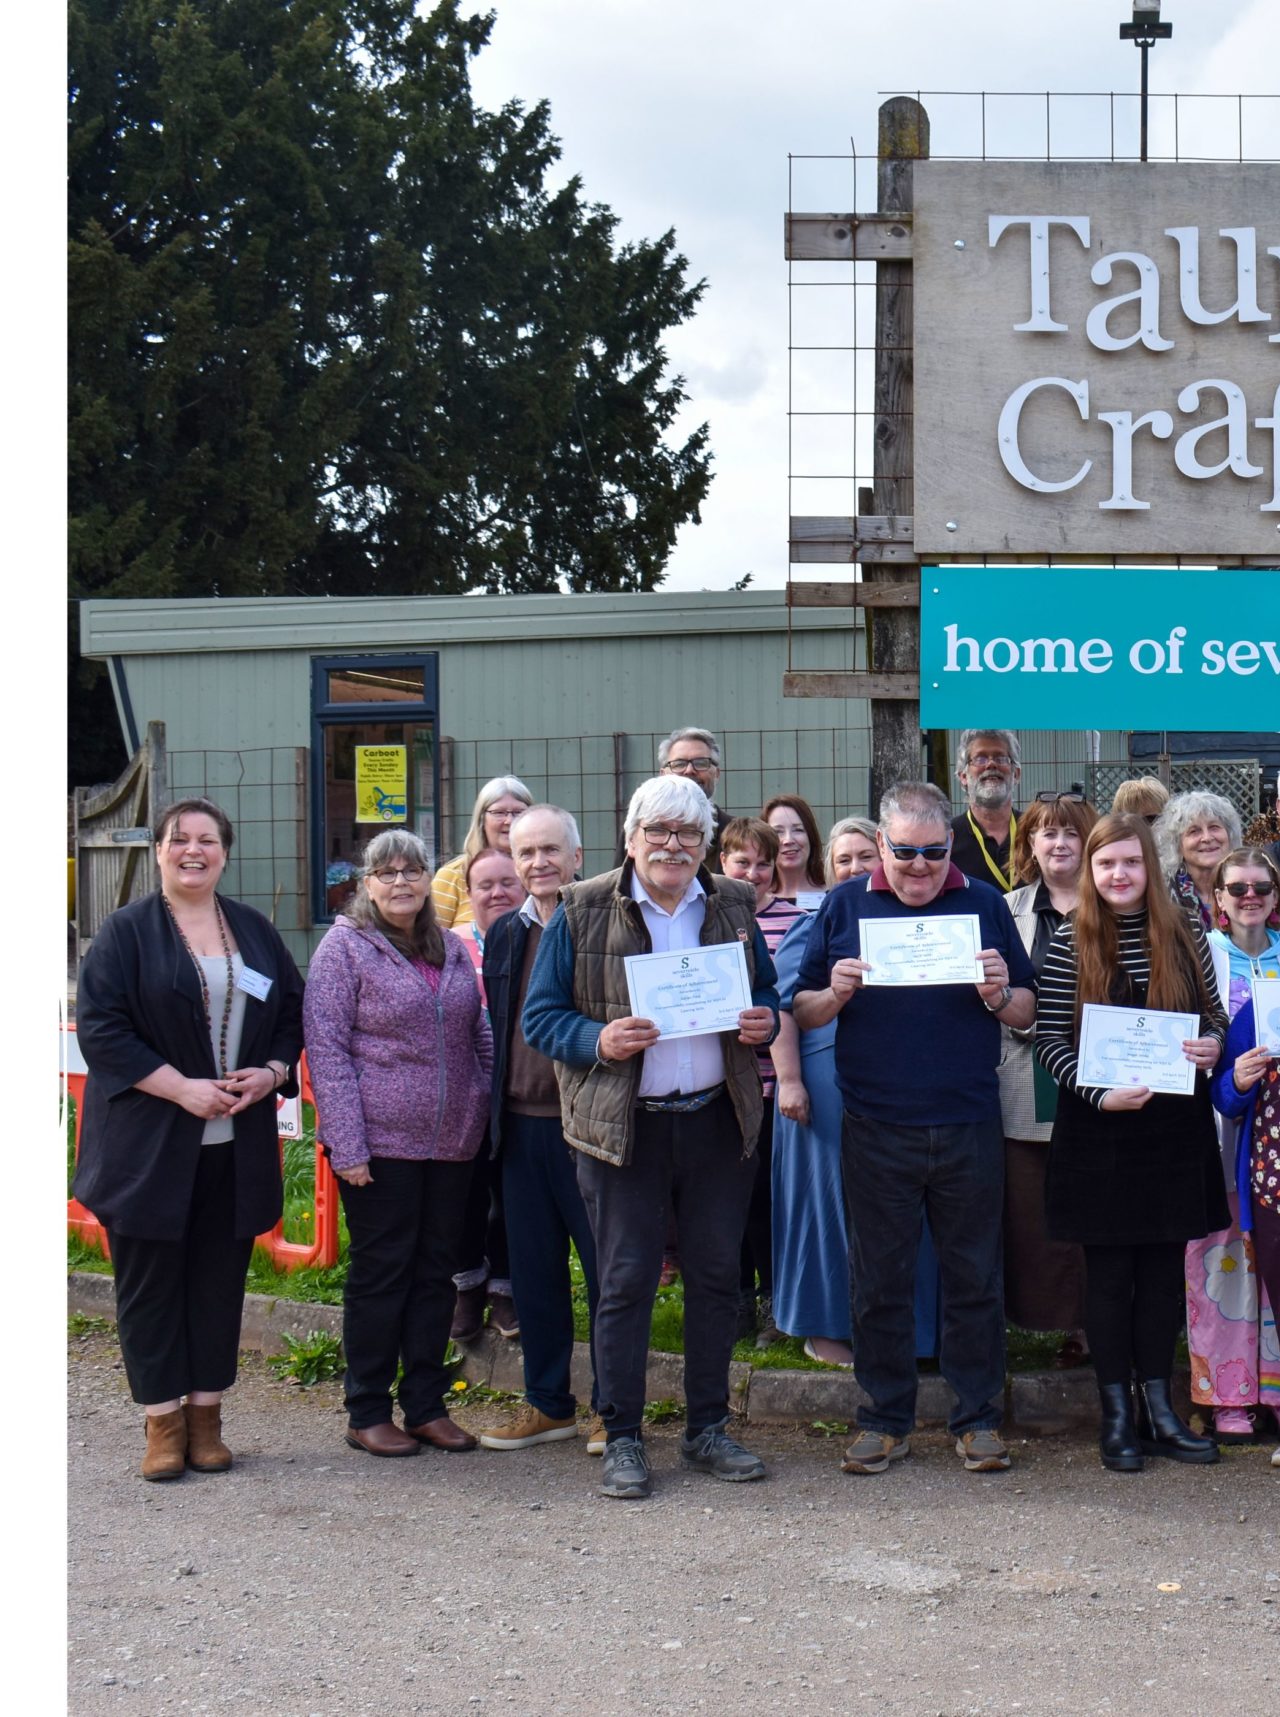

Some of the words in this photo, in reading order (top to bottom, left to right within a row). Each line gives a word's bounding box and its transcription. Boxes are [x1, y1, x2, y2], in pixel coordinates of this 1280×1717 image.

[943, 624, 1113, 673] home
[1129, 627, 1187, 674] of
[363, 749, 400, 757] Carboot
[916, 923, 925, 933] S
[681, 956, 690, 969] S
[1136, 1016, 1146, 1028] S
